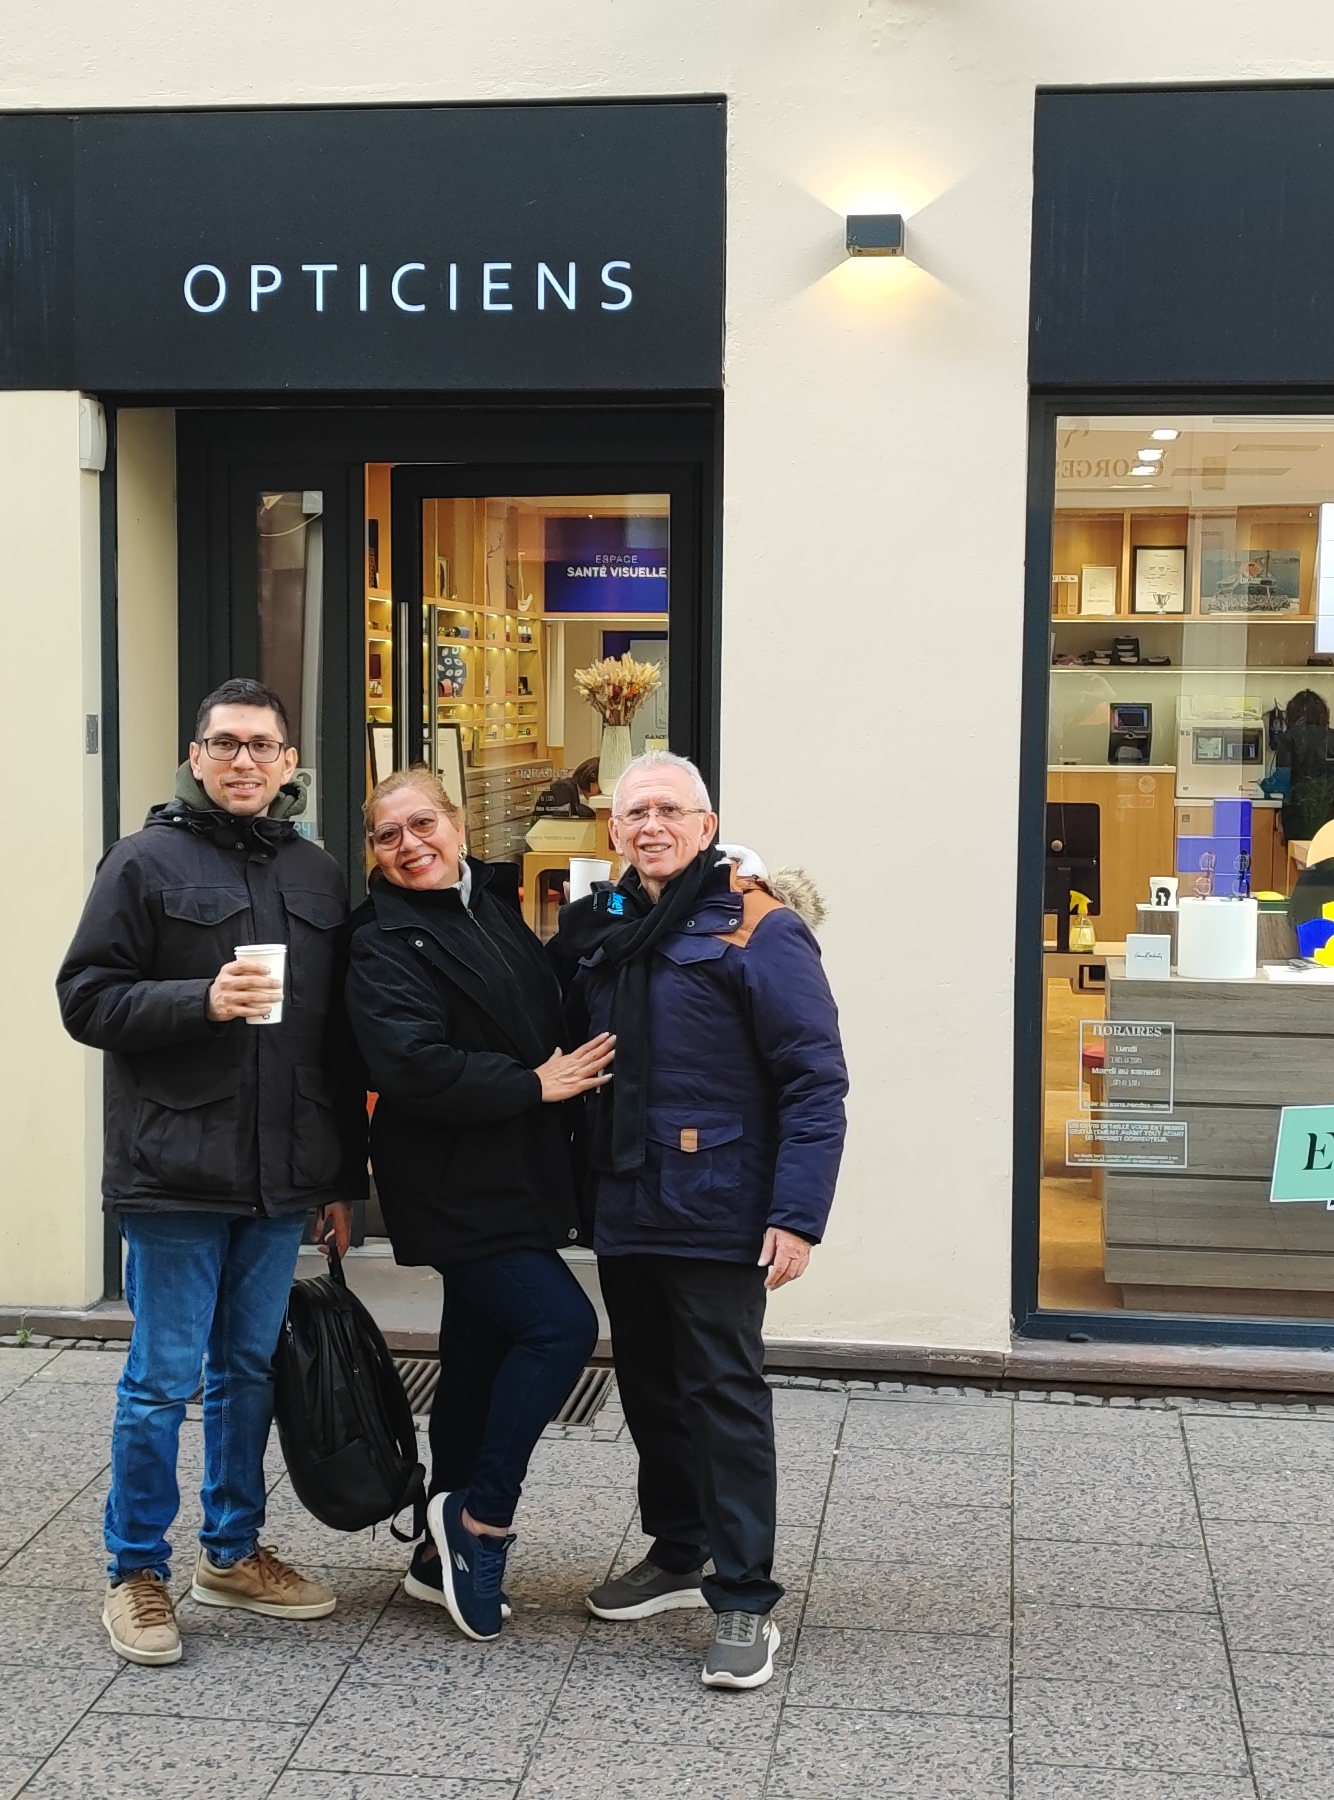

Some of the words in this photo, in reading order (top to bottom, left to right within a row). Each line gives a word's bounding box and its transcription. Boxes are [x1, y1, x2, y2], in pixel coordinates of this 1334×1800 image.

[183, 260, 634, 313] OPTICIENS
[595, 554, 638, 564] ESPACE
[567, 564, 607, 578] SANTÉ
[610, 566, 667, 579] VISUELLE
[1092, 1025, 1163, 1037] HORAIRES
